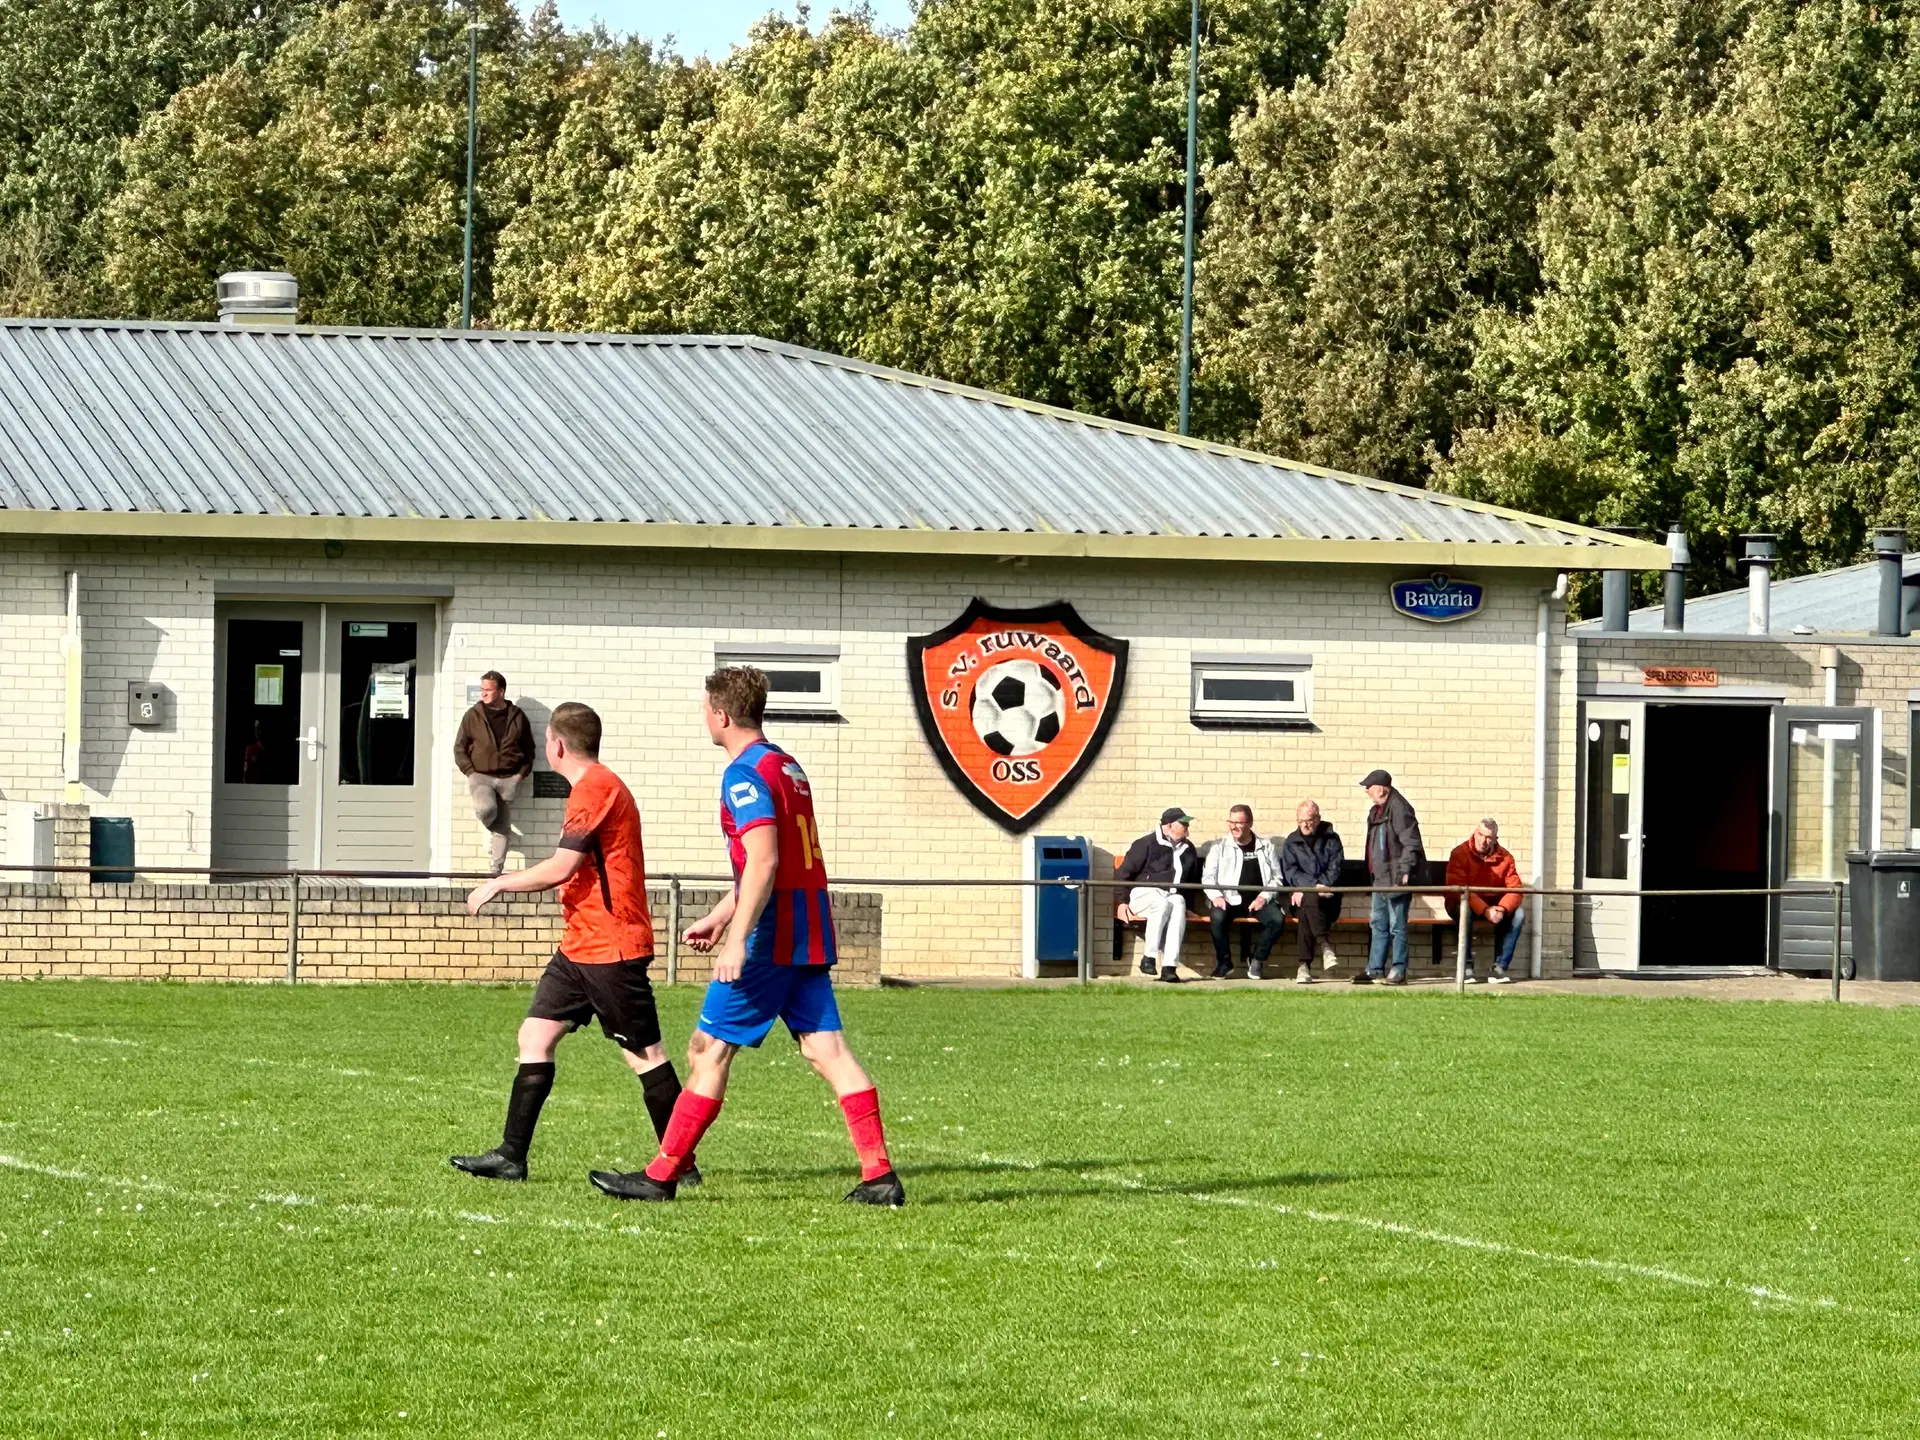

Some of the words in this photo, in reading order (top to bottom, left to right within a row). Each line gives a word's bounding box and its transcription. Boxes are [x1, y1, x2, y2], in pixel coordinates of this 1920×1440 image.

[1405, 590, 1473, 607] Bavaria
[980, 632, 1096, 710] ruwaard
[992, 760, 1041, 782] OSS
